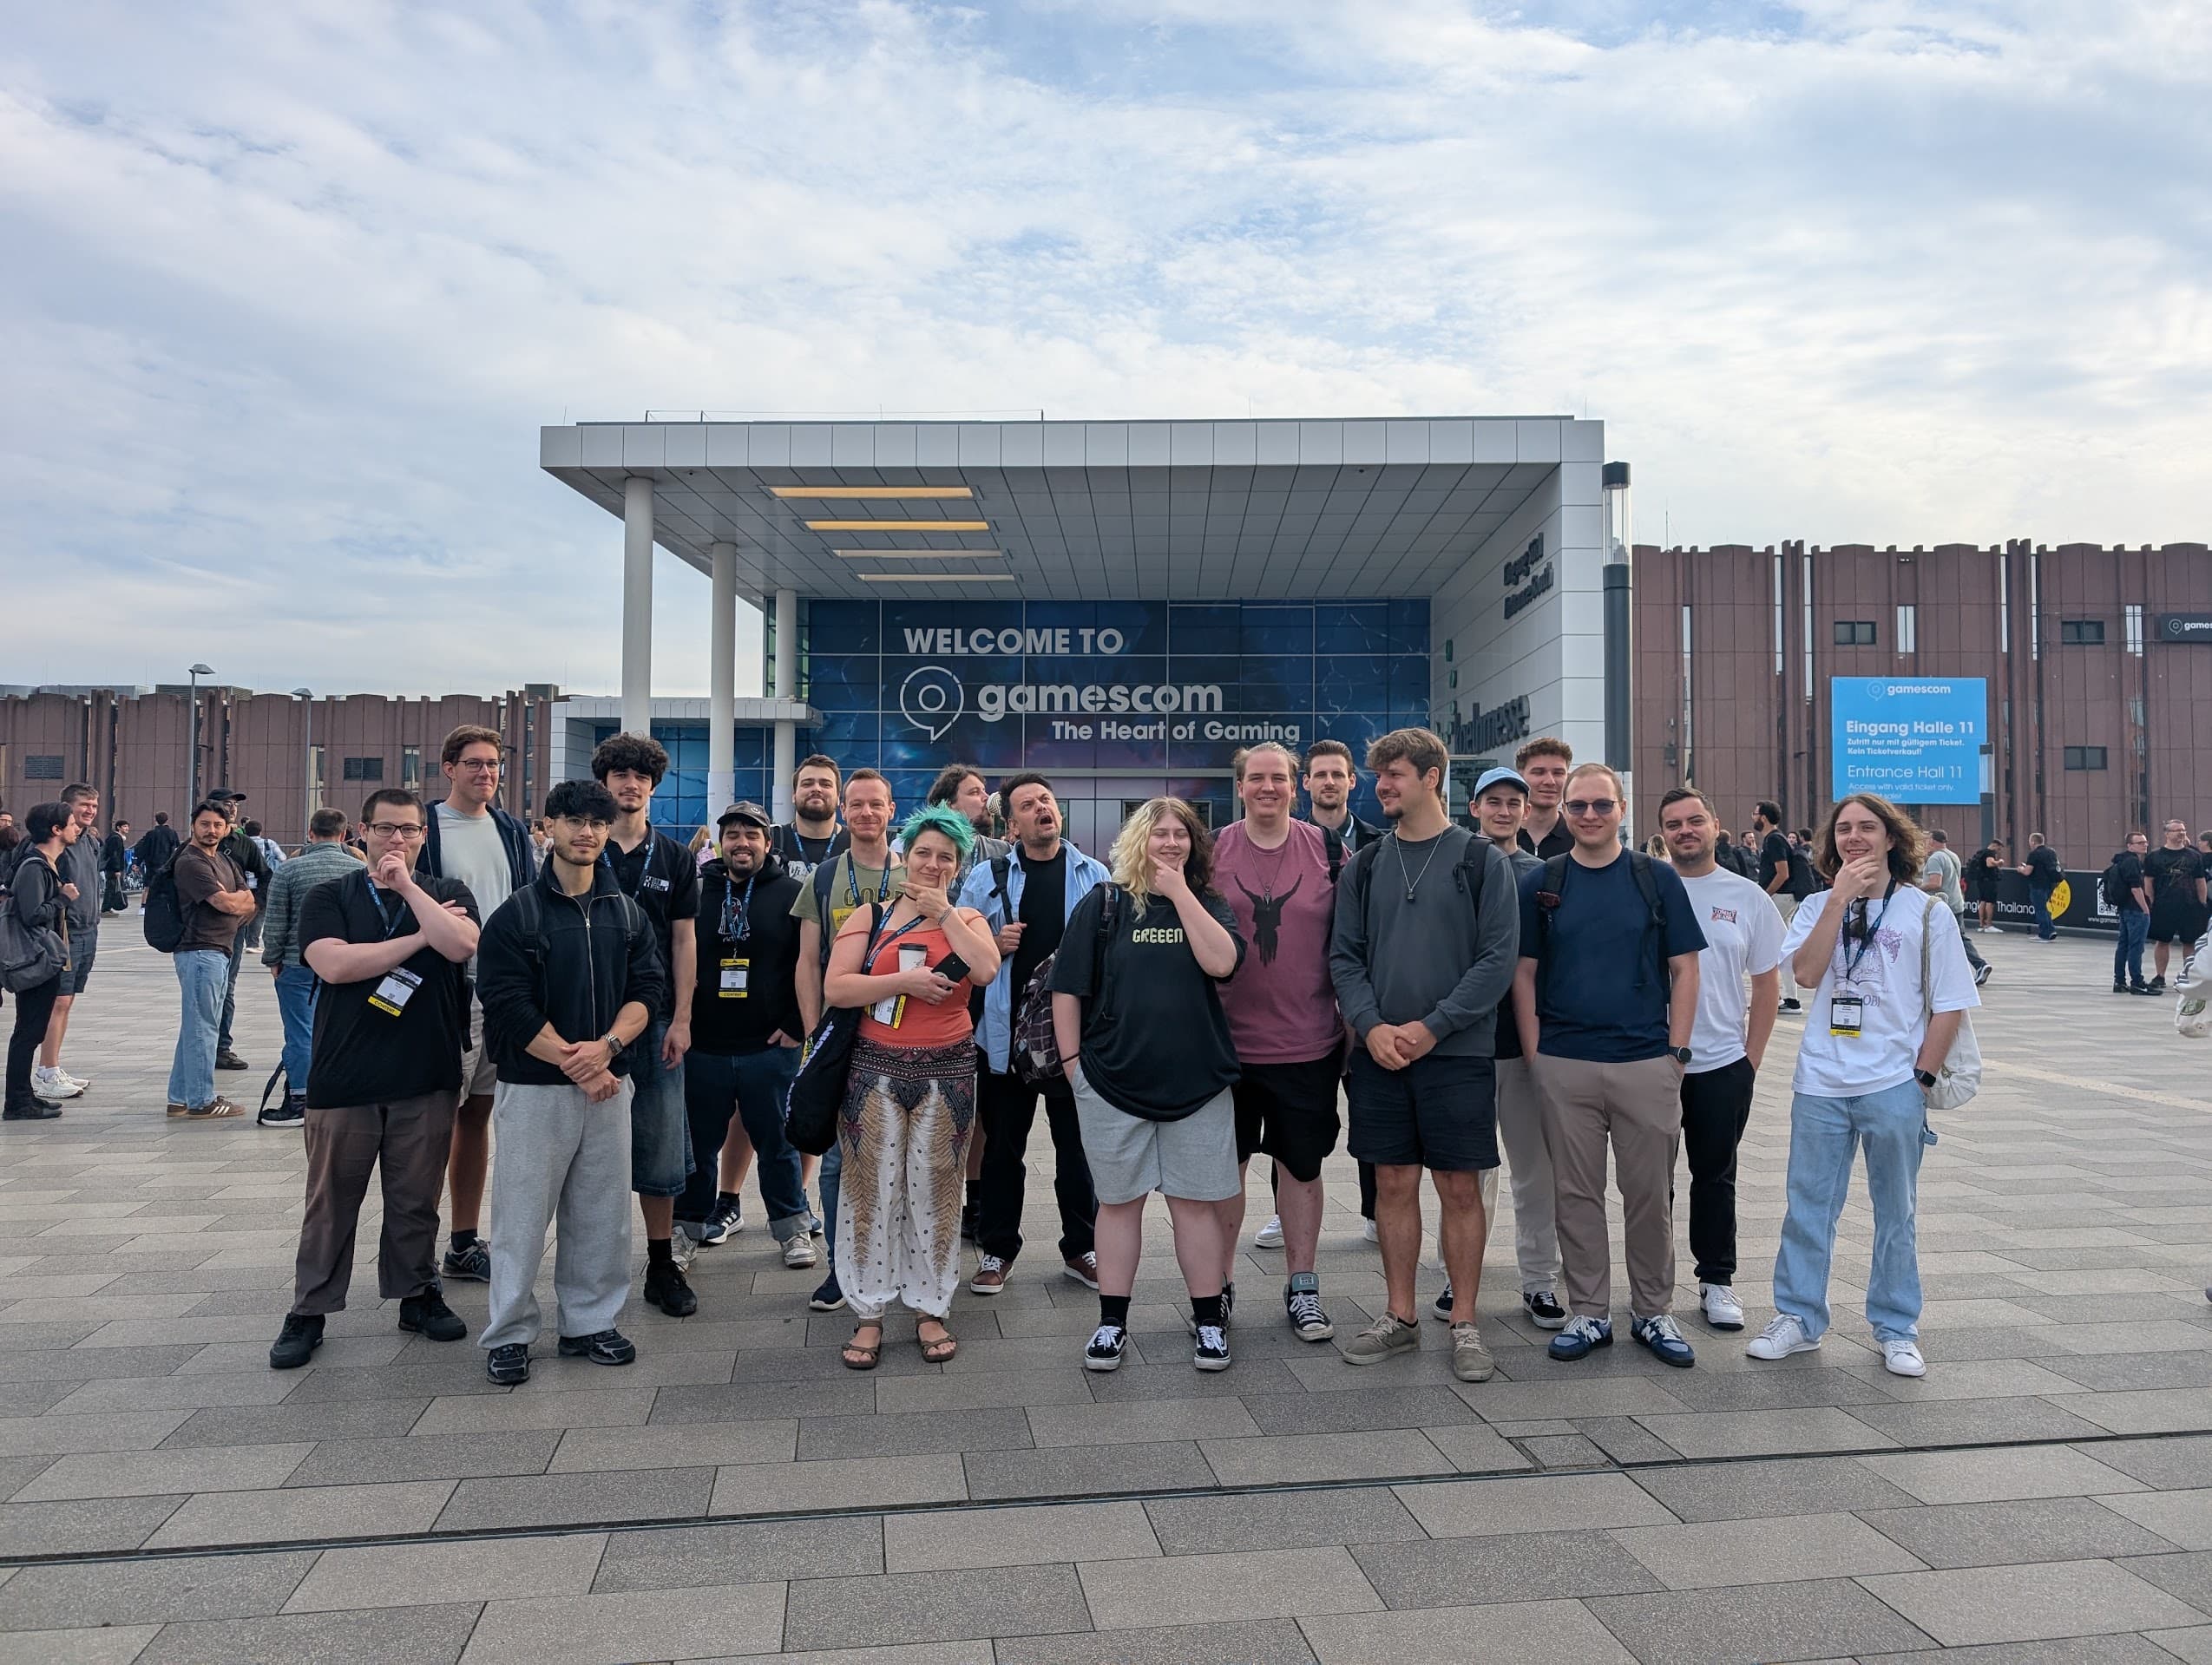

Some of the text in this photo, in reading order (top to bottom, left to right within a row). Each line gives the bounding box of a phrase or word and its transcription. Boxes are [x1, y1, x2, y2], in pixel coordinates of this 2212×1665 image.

[903, 627, 1124, 654] WELCOME TO
[1887, 685, 1951, 696] gamescom
[977, 683, 1223, 723] gamescom
[1052, 720, 1300, 746] The Heart of Gaming
[1846, 720, 1974, 736] Eingang Halle 11
[1848, 764, 1962, 778] Entrance Hall 11
[1714, 908, 1736, 918] TOMMY
[374, 1000, 396, 1013] CONTENT
